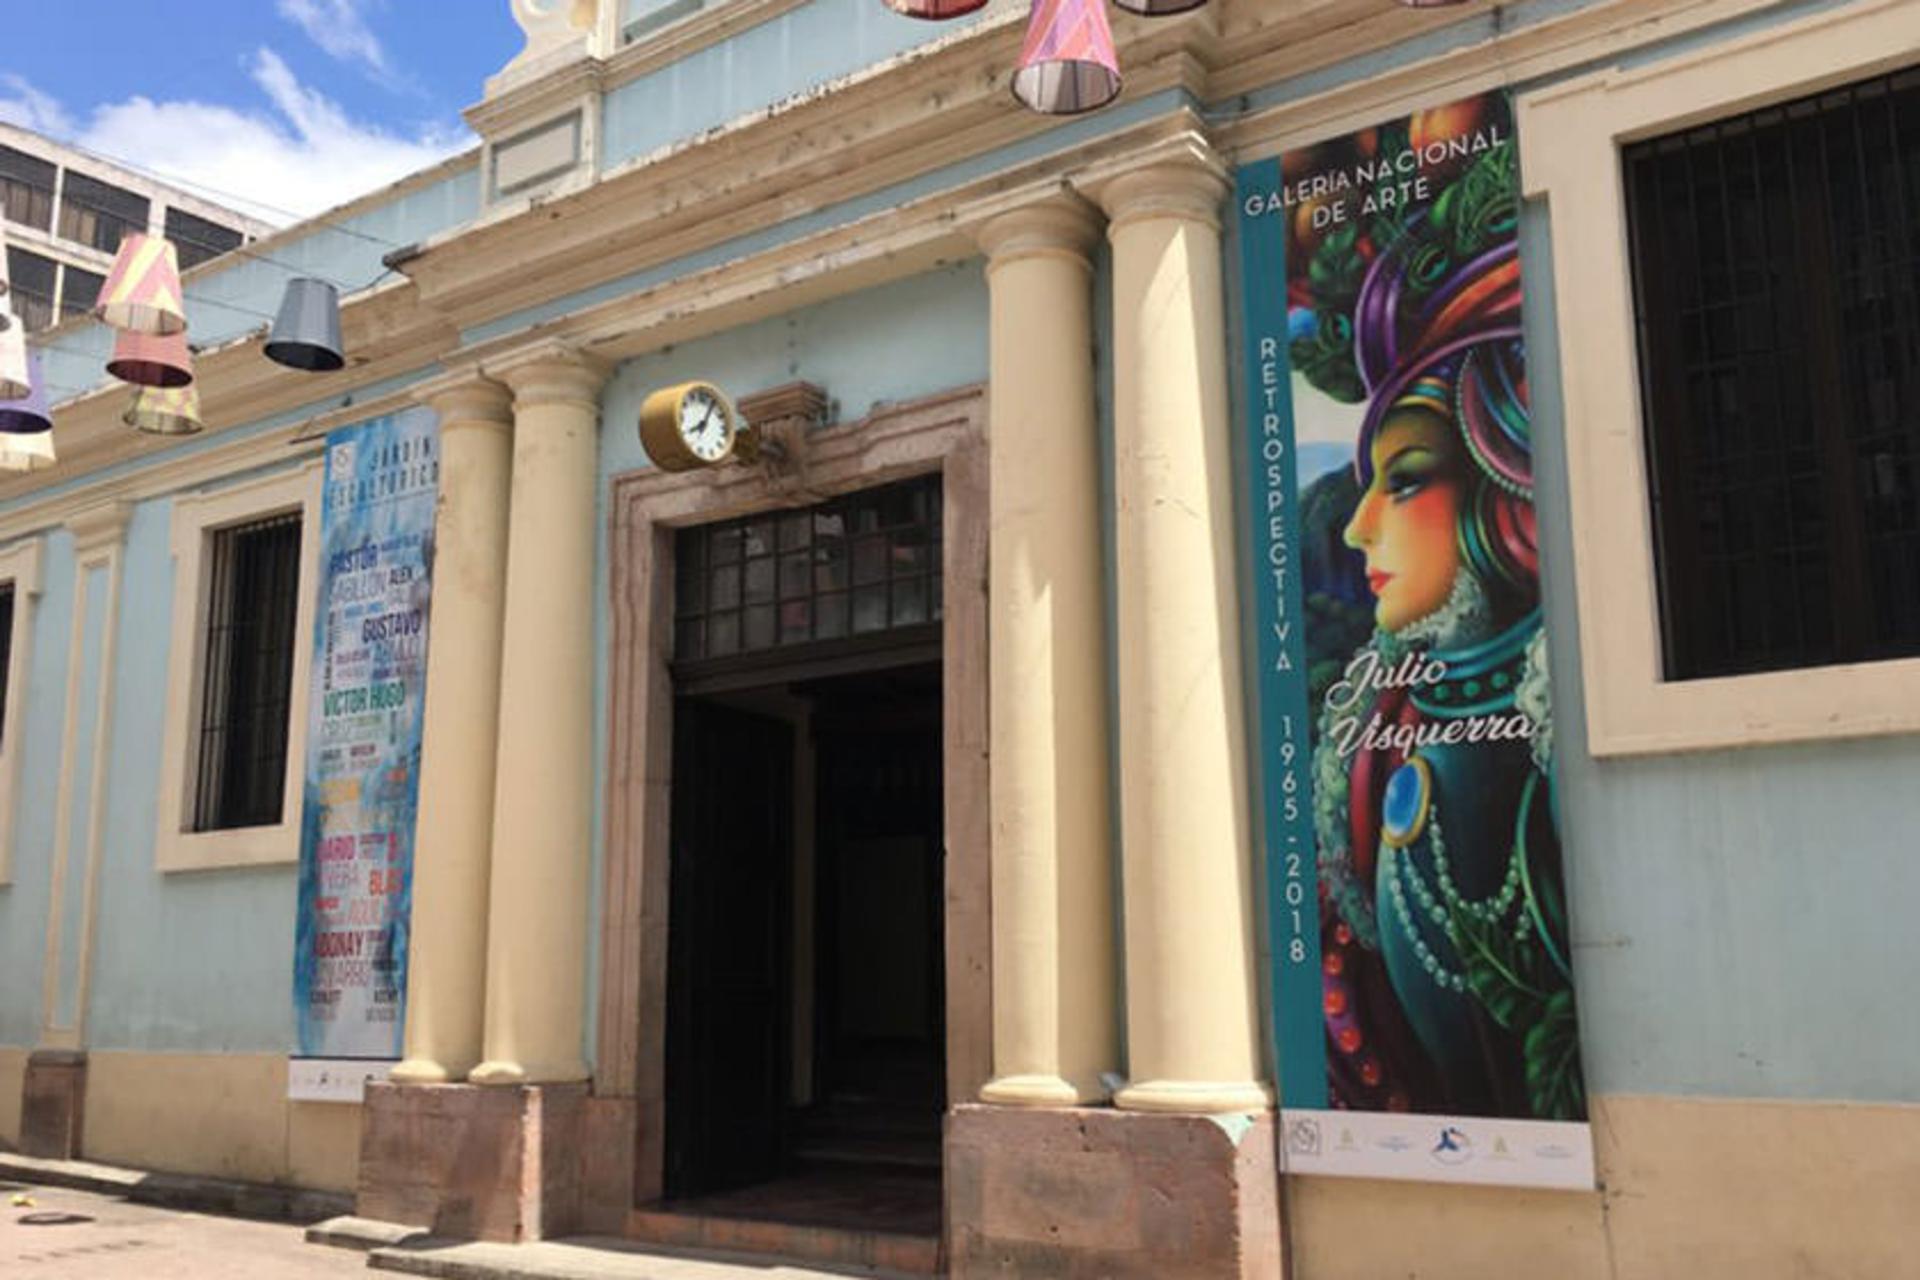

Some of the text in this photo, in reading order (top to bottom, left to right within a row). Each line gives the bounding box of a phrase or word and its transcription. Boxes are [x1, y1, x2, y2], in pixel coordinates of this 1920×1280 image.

[1356, 126, 1506, 185] NACIONAL
[1312, 177, 1430, 229] DE ARTE
[1260, 337, 1292, 671] RETROSPECTIVA
[362, 608, 422, 643] GUSTAVO
[1325, 650, 1447, 711] Julio
[1329, 711, 1537, 759] Visquerra
